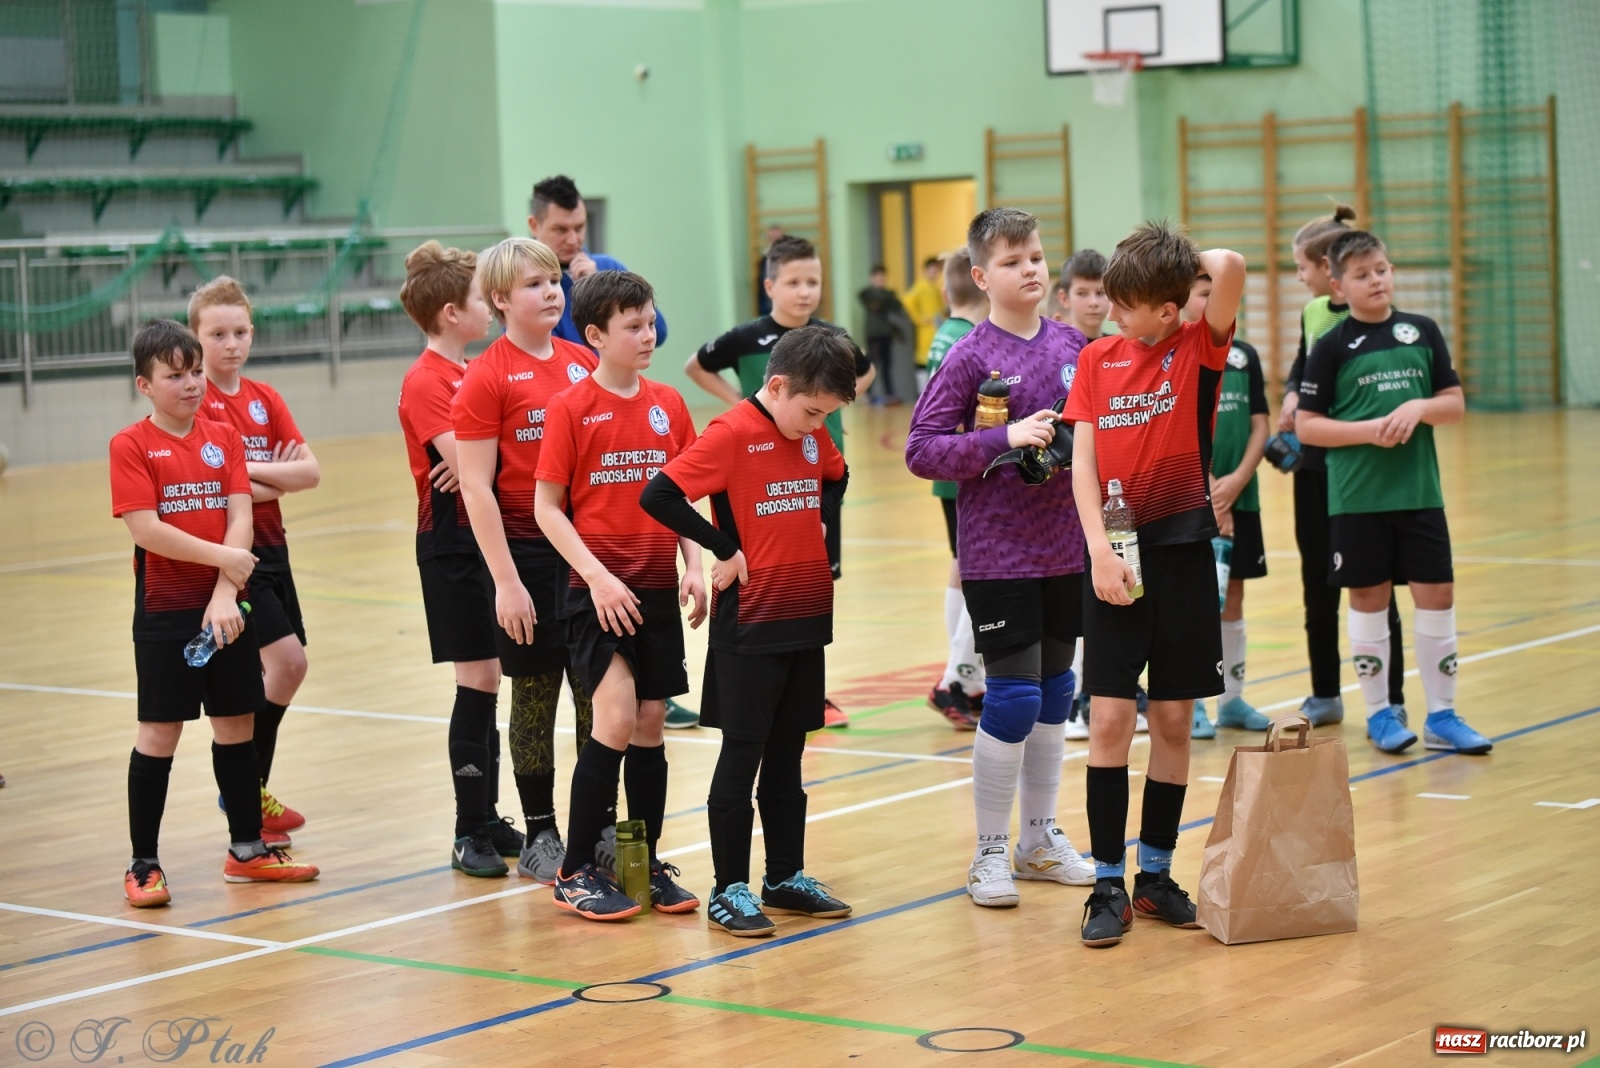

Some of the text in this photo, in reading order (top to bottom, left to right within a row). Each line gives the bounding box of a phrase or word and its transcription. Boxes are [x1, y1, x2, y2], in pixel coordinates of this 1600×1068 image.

[1377, 380, 1410, 392] BRAVO
[589, 467, 643, 486] RADOSŁAW
[755, 496, 805, 516] RADOSŁAW
[1333, 551, 1343, 571] 9
[979, 620, 1006, 633] COLO
